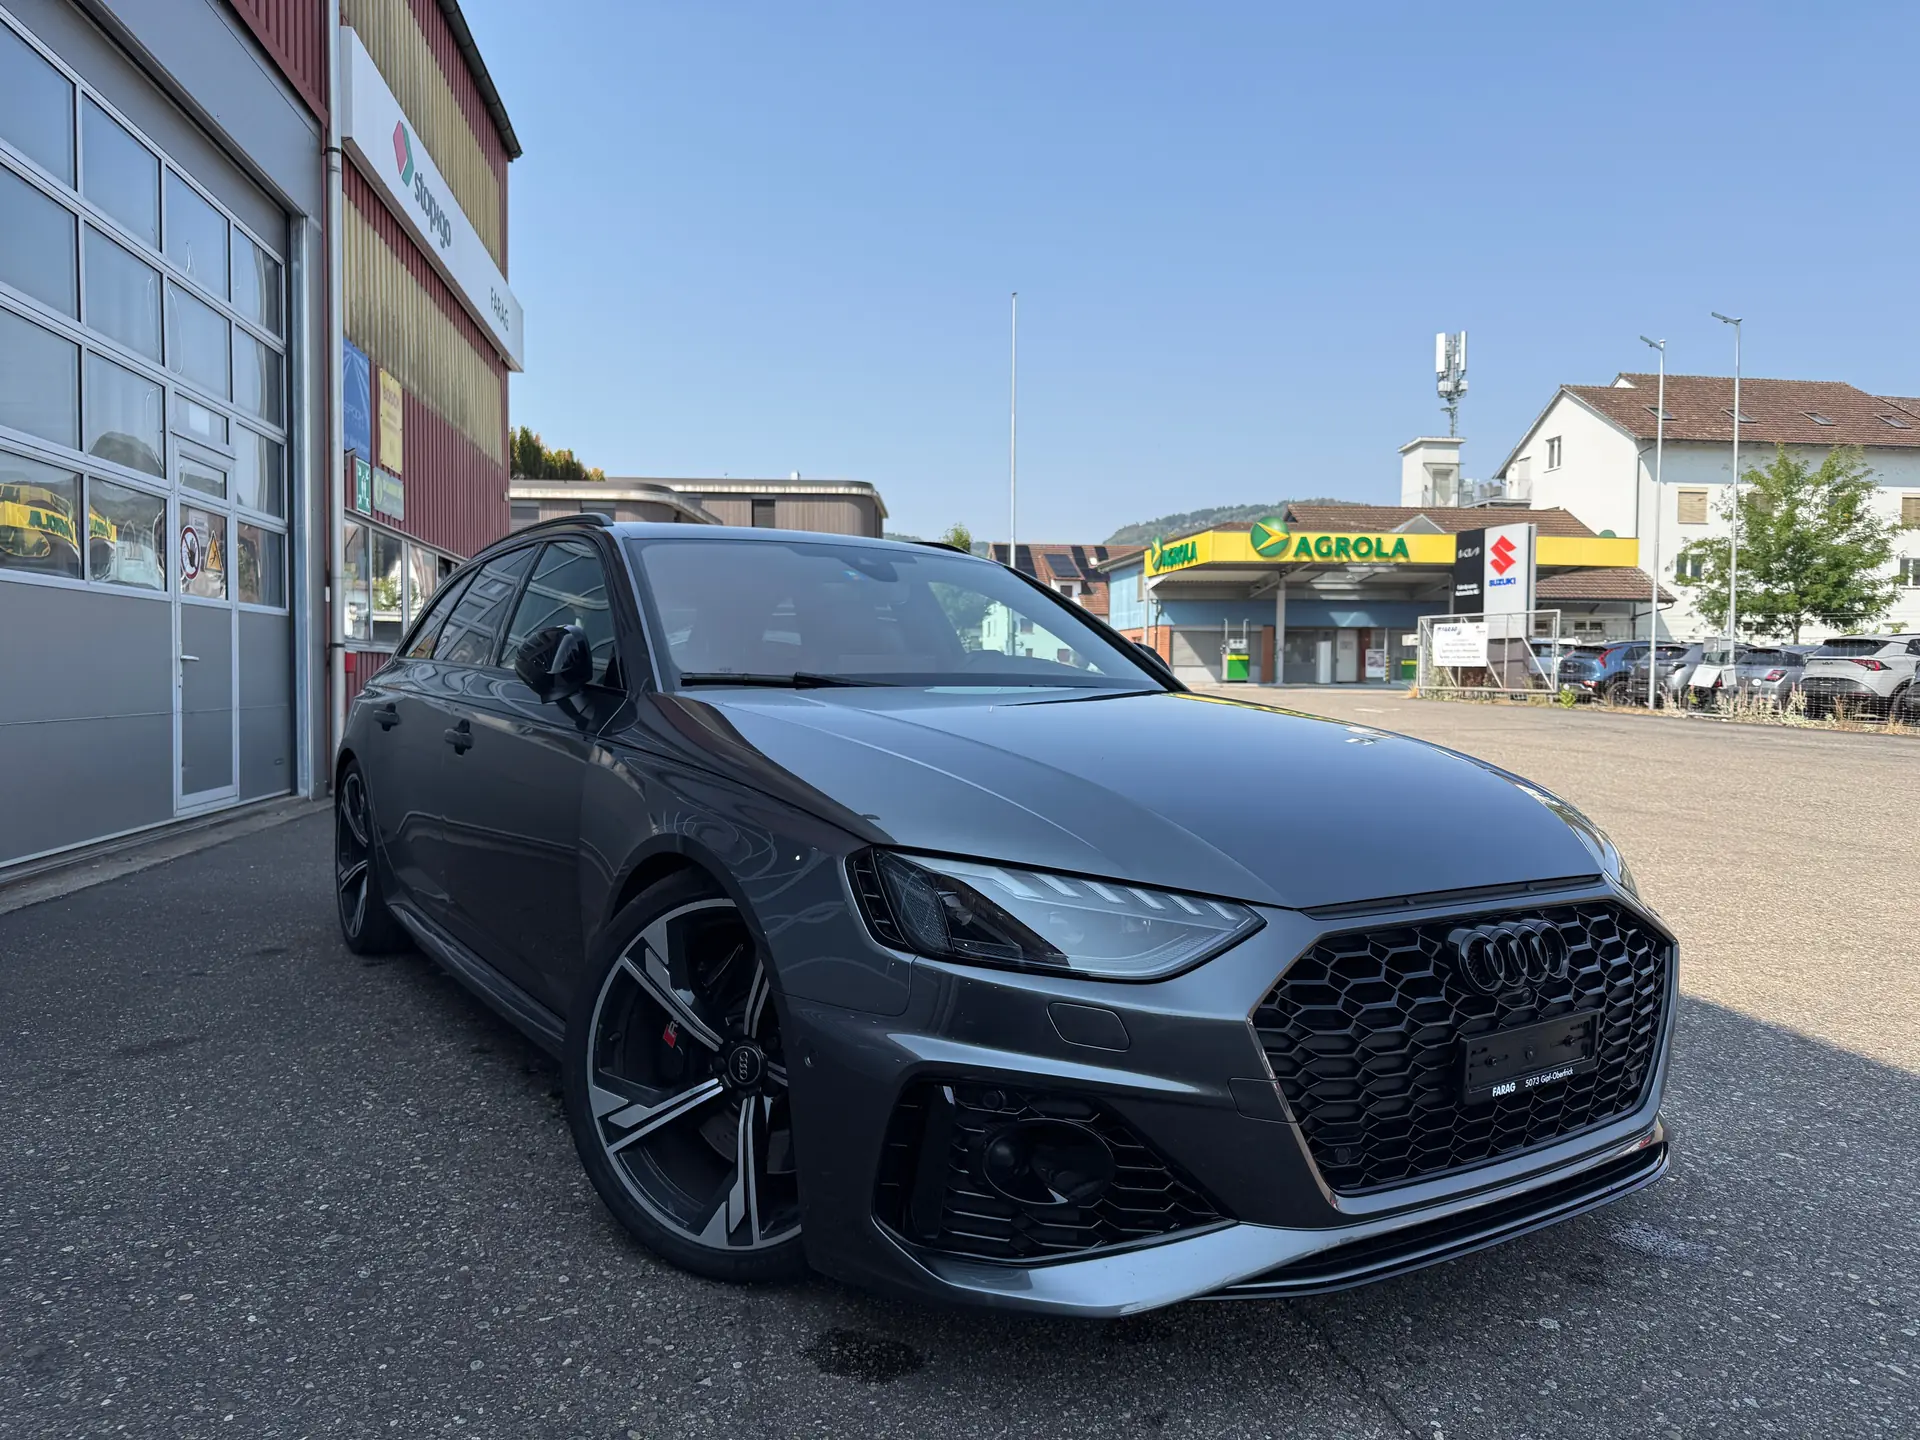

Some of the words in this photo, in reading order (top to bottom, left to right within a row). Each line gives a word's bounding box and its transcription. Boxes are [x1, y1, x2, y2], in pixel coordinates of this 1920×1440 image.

[490, 286, 509, 332] FARAG
[1162, 540, 1197, 567] AGROLA
[1293, 535, 1410, 559] AGROLA
[1457, 546, 1480, 559] KIA
[1488, 577, 1517, 587] SUZUKI
[1492, 1081, 1516, 1097] FARAG
[1525, 1077, 1540, 1088] 5073
[1540, 1067, 1574, 1084] Gipf-Oberfrick
